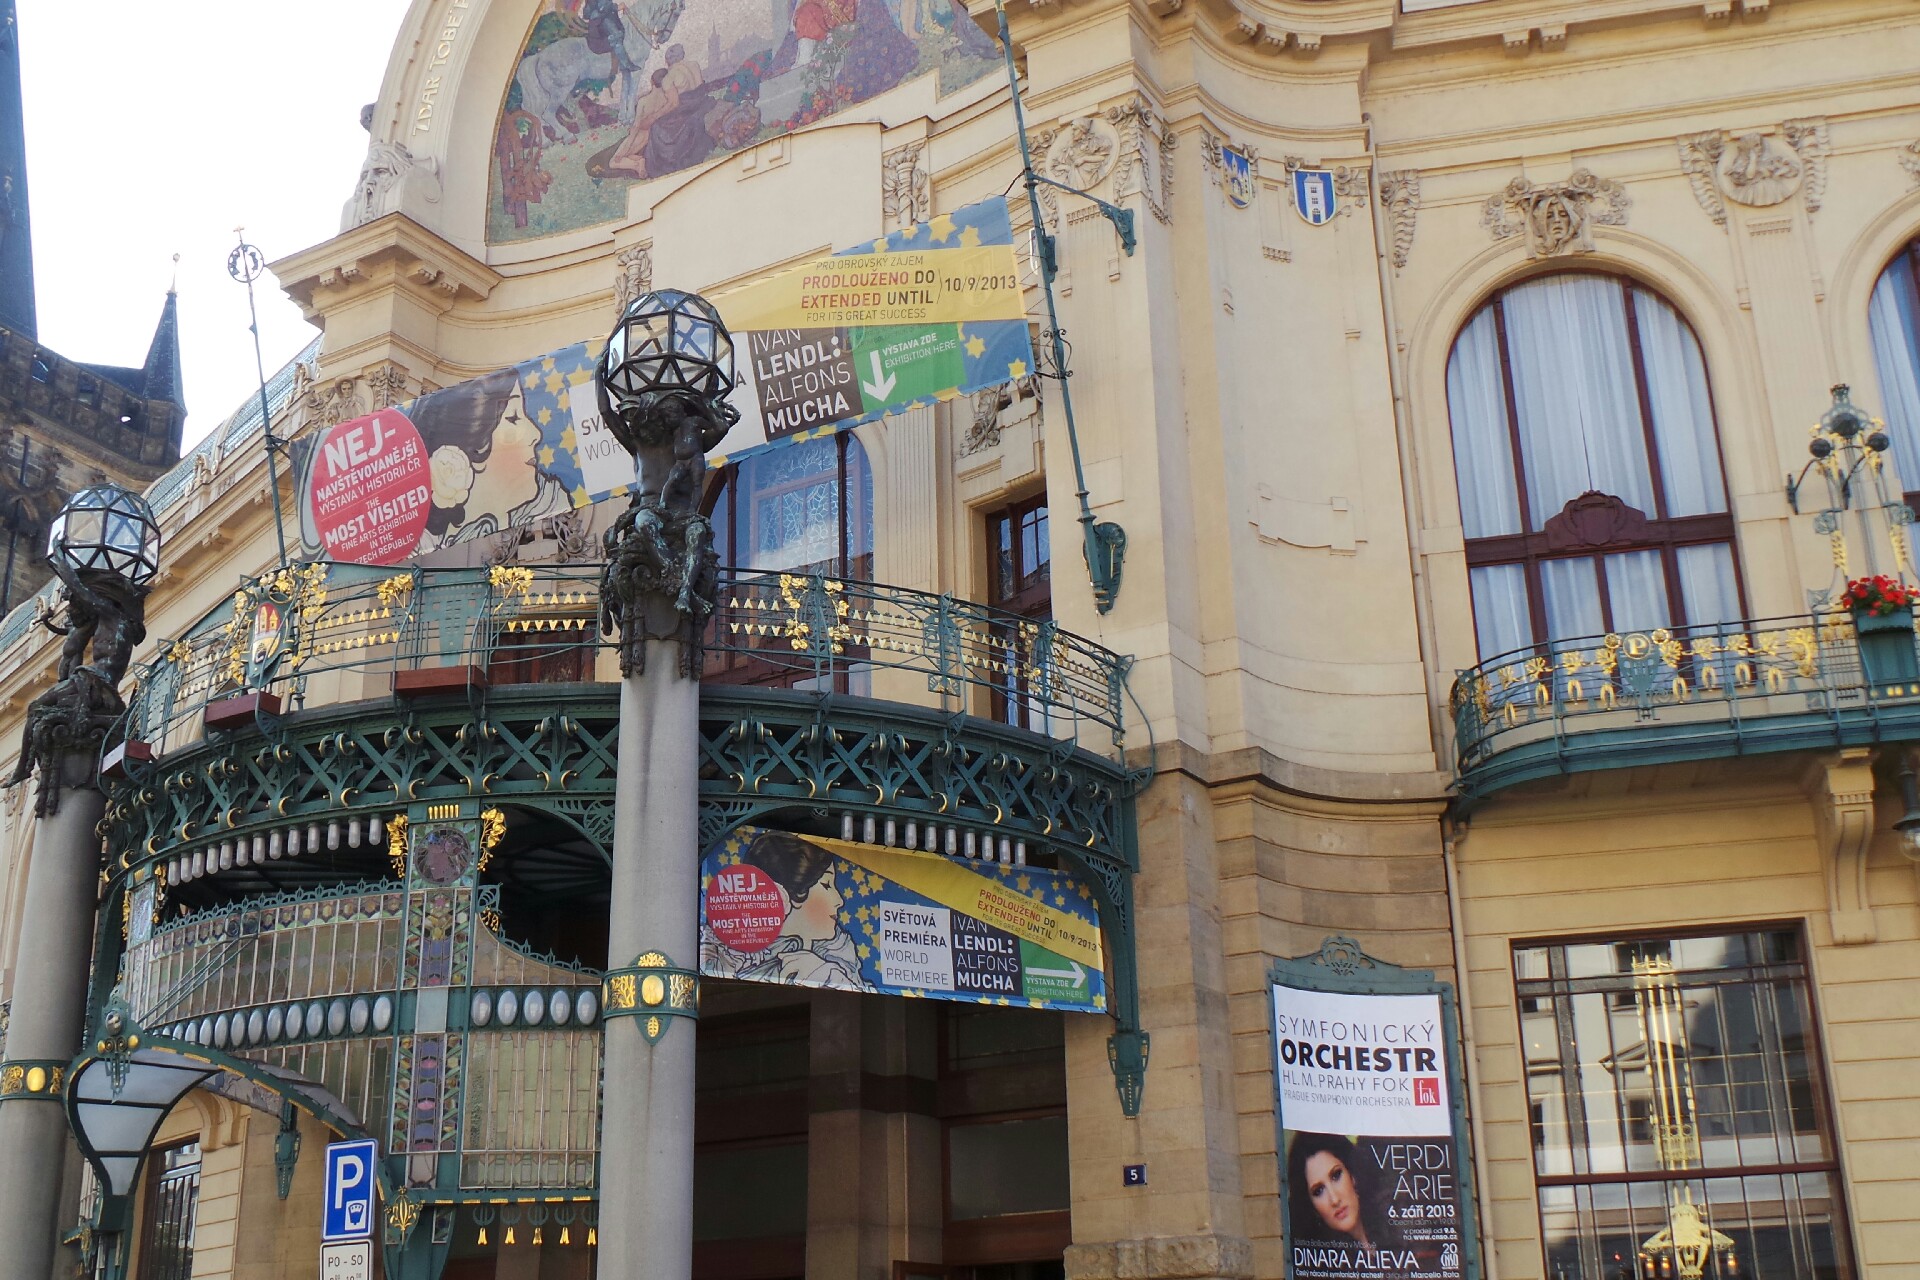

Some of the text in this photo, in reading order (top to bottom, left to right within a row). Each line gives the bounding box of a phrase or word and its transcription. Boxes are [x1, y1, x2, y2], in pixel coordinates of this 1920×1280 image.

[815, 260, 835, 270] PRO
[837, 255, 888, 269] OBROVSKÝ
[802, 268, 935, 290] PRODLOUŽENO DO
[944, 274, 1017, 293] 10/9/2013
[801, 290, 934, 309] EXTENDED UNTIL
[806, 308, 927, 322] FOR ITS GREAT SUCCESS
[753, 329, 801, 355] IVAN
[882, 332, 938, 356] VÝSTAVA ZDE
[757, 335, 841, 380] LENDL:
[884, 340, 957, 369] EXHIBITION HERE
[765, 362, 851, 407] ALFONS
[767, 391, 850, 434] MUCHA
[324, 418, 396, 478] NEJ-
[316, 437, 419, 502] NAVŠTĚVOVANĚJŠÍ
[318, 457, 422, 516] VÝSTAVA V HISTORII ČR
[365, 496, 381, 510] THE
[324, 485, 430, 548] MOST VISITED
[341, 508, 419, 553] FINE ARTS EXHIBITION
[369, 532, 394, 550] IN THE
[379, 532, 415, 557] REPUBLIC
[718, 874, 765, 893] NEJ-
[883, 908, 937, 928] SVĚTOVÁ
[980, 889, 1056, 929] PRODLOUŽENO DO
[713, 917, 781, 929] MOST VISITED
[953, 914, 988, 933] IVAN
[977, 900, 1053, 940] EXTENDED UNTIL
[884, 930, 947, 948] PREMIÉRA
[954, 933, 1014, 954] LENDL:
[1059, 929, 1097, 952] 10/9/2013
[884, 948, 929, 964] WORLD
[956, 953, 1019, 973] ALFONS
[886, 967, 949, 985] PREMIERE
[957, 971, 1015, 991] MUCHA
[1056, 979, 1069, 987] ZDE
[1027, 986, 1084, 999] EXHIBITION HERE
[1278, 1014, 1435, 1043] SYMFONICKÝ
[1280, 1038, 1439, 1072] ORCHESTR
[1373, 1077, 1411, 1092] FOK
[1416, 1079, 1437, 1105] fok
[1284, 1089, 1412, 1107] PRAGUE SYMPHONY ORCHESTRA
[1370, 1144, 1450, 1169] VERDI
[334, 1154, 364, 1209] P
[1130, 1169, 1138, 1181] 5
[1393, 1169, 1454, 1200] ÁRIE
[1388, 1204, 1455, 1218] 6. září 2013
[1294, 1247, 1420, 1269] DINARA ALIEVA
[1442, 1243, 1458, 1254] 20
[328, 1256, 340, 1267] PO
[351, 1254, 363, 1266] SO
[1410, 1271, 1442, 1279] Marcello
